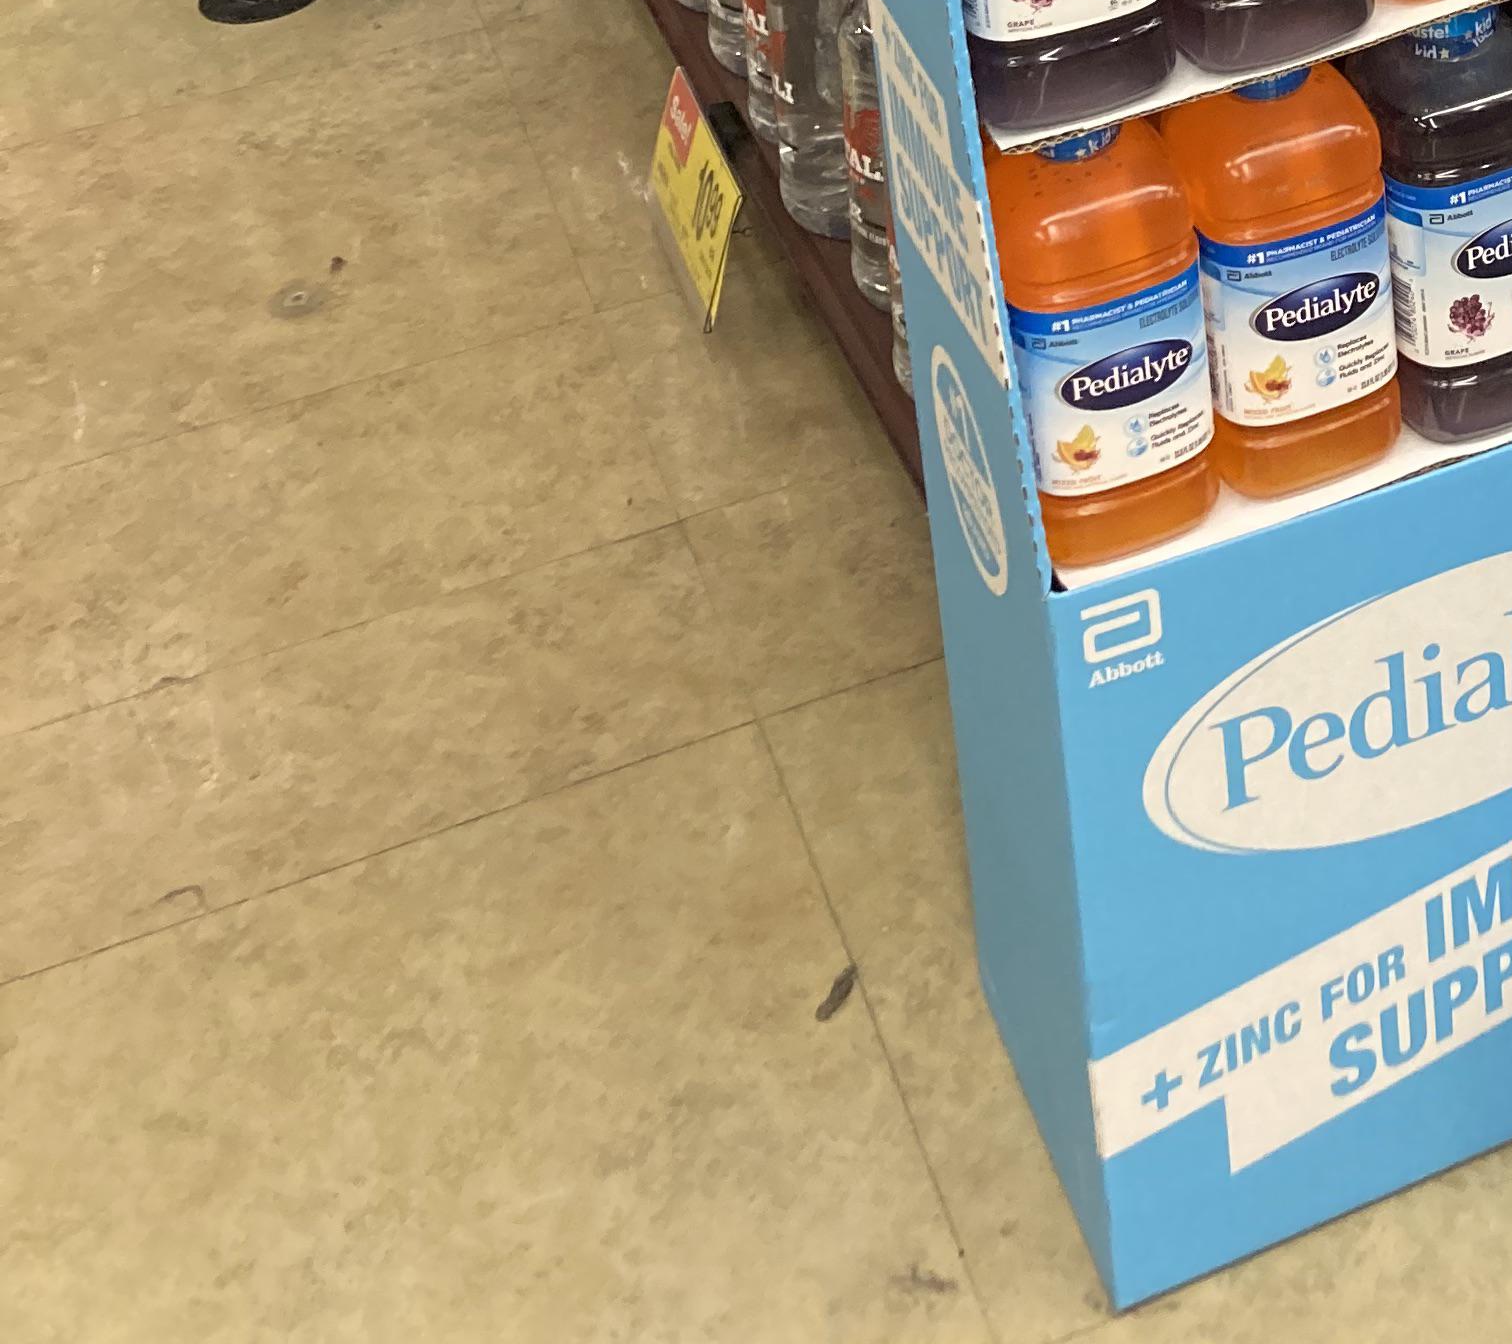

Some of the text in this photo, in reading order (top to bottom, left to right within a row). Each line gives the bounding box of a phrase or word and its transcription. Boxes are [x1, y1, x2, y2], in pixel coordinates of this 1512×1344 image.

[1265, 278, 1377, 332] Pedialyte
[1072, 346, 1190, 402] Pedialyte
[1088, 650, 1165, 689] Abbott
[1198, 1001, 1303, 1079] ZINC
[1319, 944, 1407, 1024] FOR
